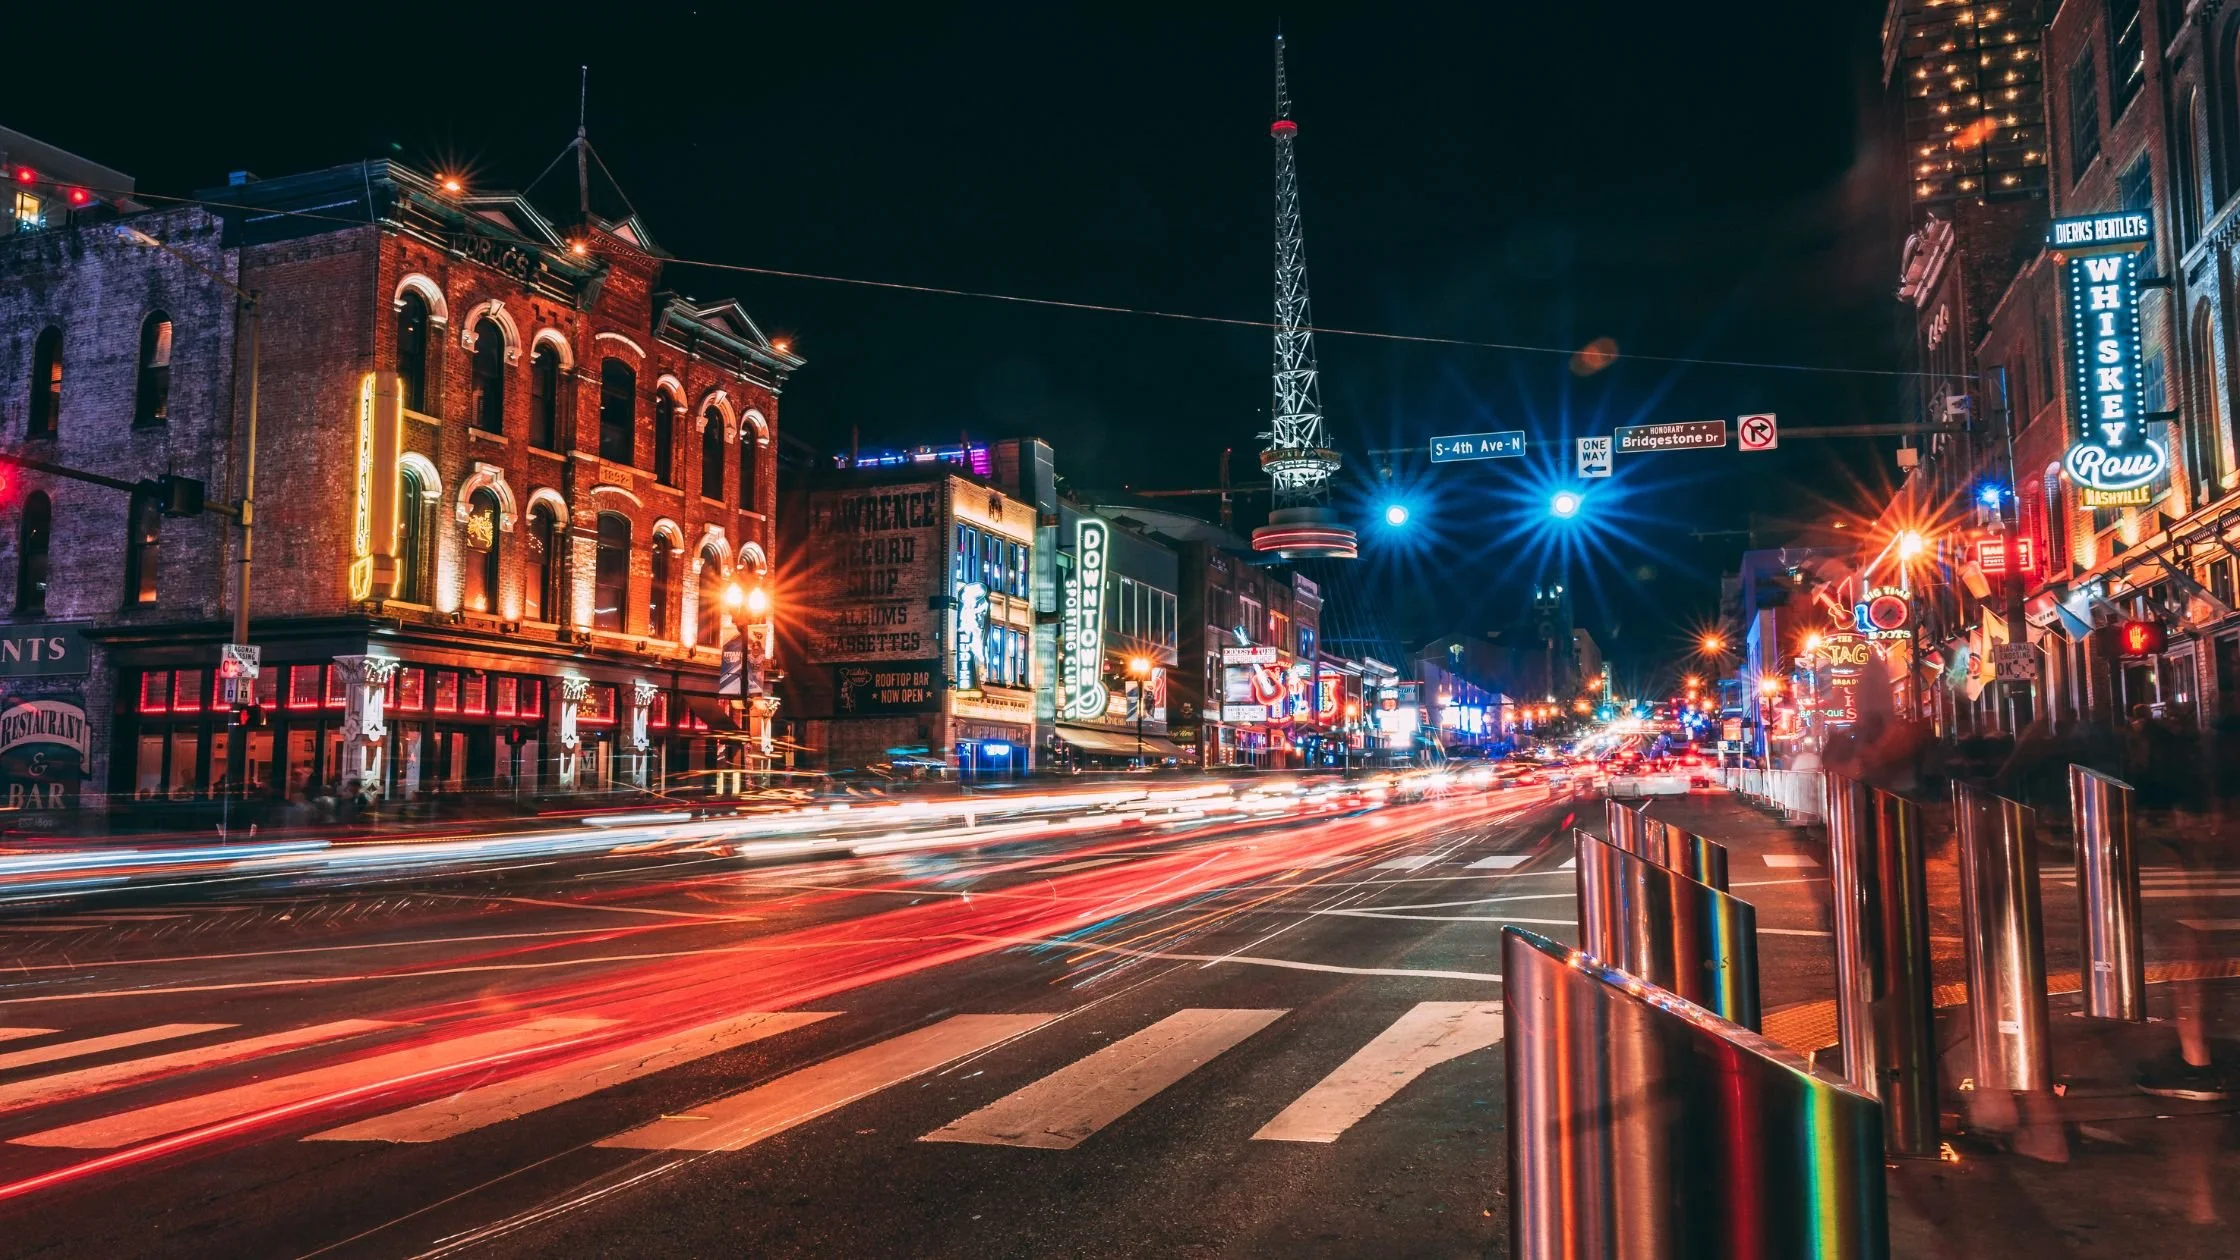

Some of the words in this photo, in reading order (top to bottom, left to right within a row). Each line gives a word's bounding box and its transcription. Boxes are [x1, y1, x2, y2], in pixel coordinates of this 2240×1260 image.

[2055, 219, 2094, 244] DIERKS
[2085, 257, 2126, 446] WHISKEY
[1650, 424, 1685, 435] HONORARY
[1583, 440, 1606, 450] ONE
[1622, 433, 1703, 448] Bridgestone
[1705, 433, 1719, 443] Dr
[1582, 451, 1607, 462] WAY
[2076, 446, 2157, 482] Row
[2086, 485, 2150, 505] NASHVILLE
[1862, 589, 1883, 602] BIG
[1883, 586, 1911, 600] TIME
[839, 606, 908, 627] ALBUMS
[1065, 580, 1077, 654] SPORTING
[1081, 529, 1101, 688] DOWNTOWN
[826, 632, 921, 654] CASSETTES
[1837, 635, 1853, 643] THE
[1868, 630, 1912, 640] BOOTS
[1064, 655, 1077, 694] CLUB
[1997, 662, 2014, 676] OK
[875, 672, 912, 688] ROOFTOP
[913, 671, 930, 686] BAR
[881, 689, 900, 704] NOW
[901, 688, 923, 703] OPEN
[1, 709, 84, 748] RESTAURANT
[28, 752, 48, 776] &
[9, 783, 66, 810] BAR
